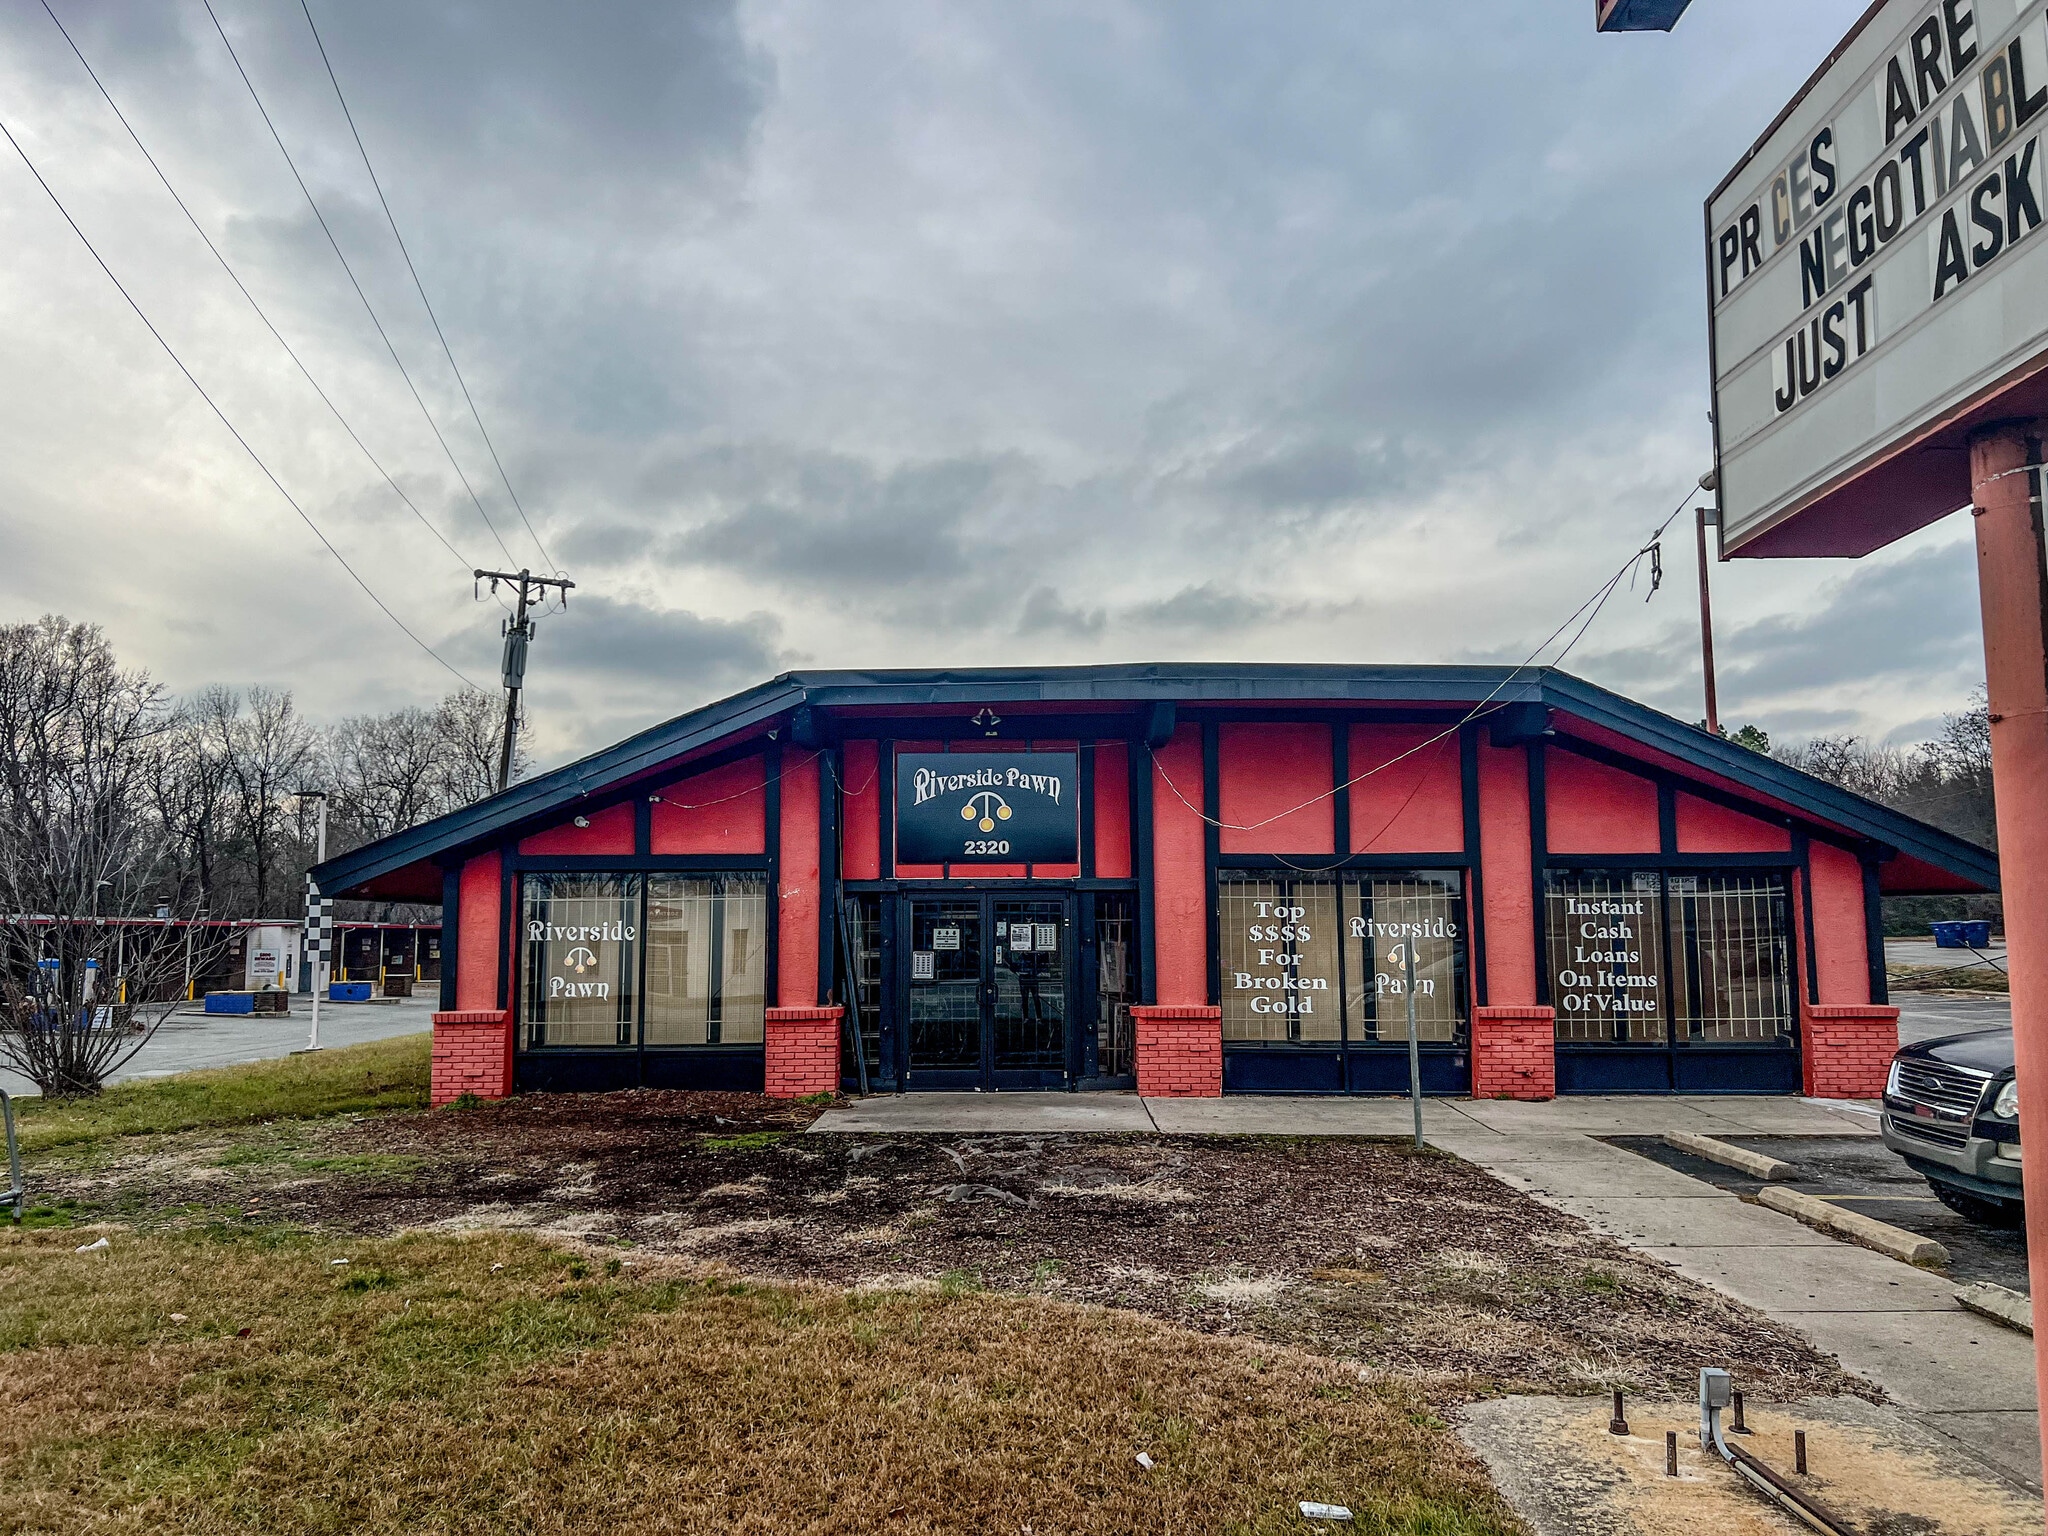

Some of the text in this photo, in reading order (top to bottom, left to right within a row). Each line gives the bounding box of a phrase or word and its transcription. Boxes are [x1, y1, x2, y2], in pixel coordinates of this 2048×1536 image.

[1885, 0, 1978, 145] ARE
[1800, 8, 2048, 310] NEGOTIABL
[1775, 135, 2042, 412] JUST ASK
[913, 767, 1060, 806] Riverside Pawn
[964, 840, 1010, 855] 2320
[1253, 901, 1305, 924] Top
[1567, 898, 1644, 915] Instant
[527, 920, 636, 942] Riverside
[1249, 924, 1311, 942] $$$$
[1348, 917, 1457, 938] Riverside
[1580, 922, 1633, 939] Cash
[1258, 949, 1304, 966] For
[1575, 946, 1639, 963] Loans
[1234, 972, 1328, 990] Broken
[1559, 970, 1658, 987] On Items
[549, 976, 610, 1001] Pawn
[1250, 996, 1313, 1014] Gold
[1563, 994, 1656, 1012] Of Value
